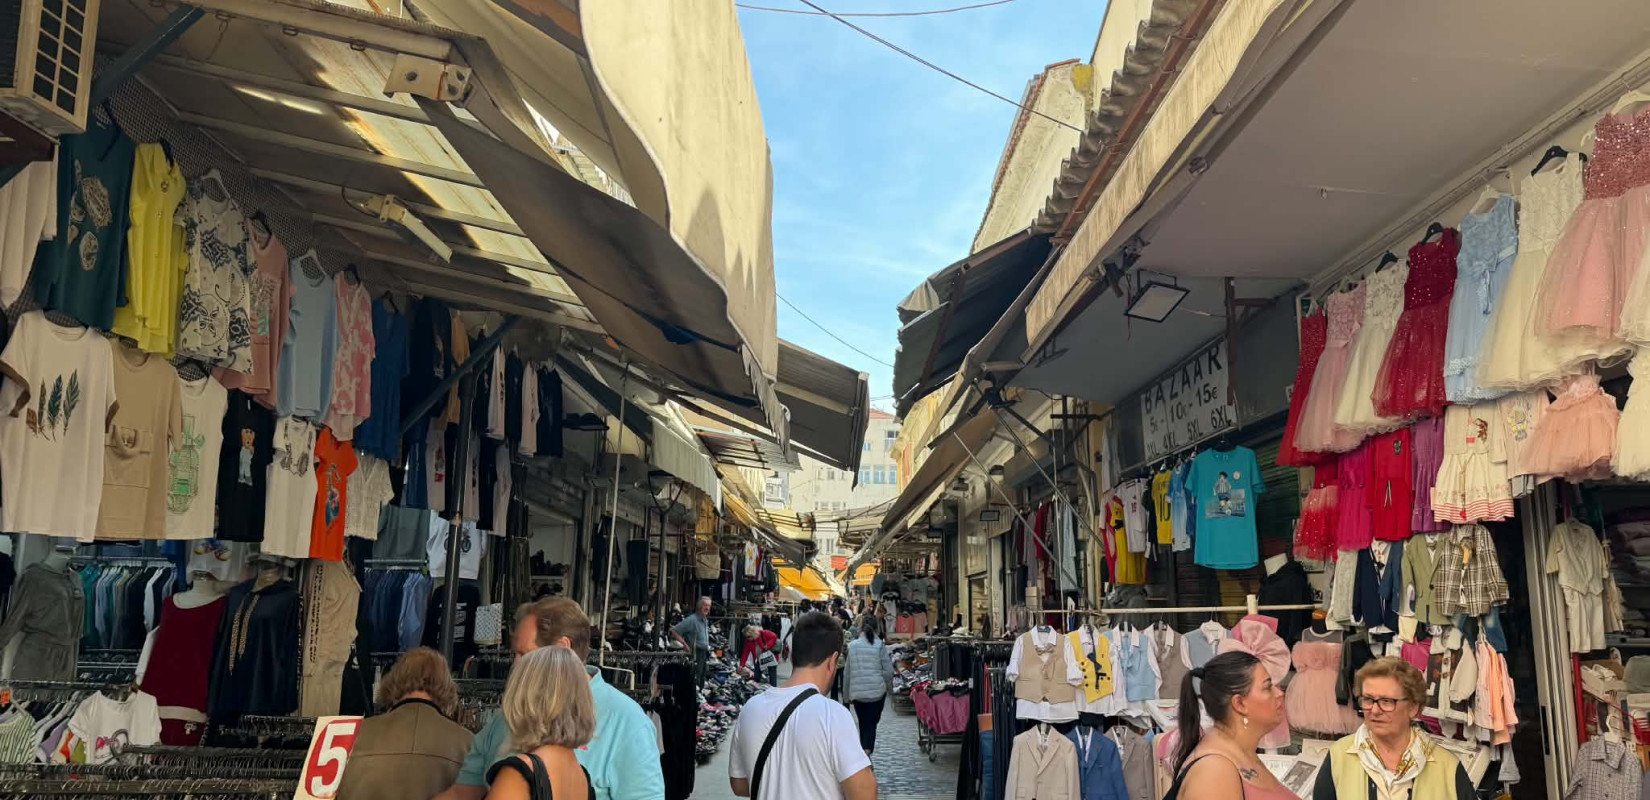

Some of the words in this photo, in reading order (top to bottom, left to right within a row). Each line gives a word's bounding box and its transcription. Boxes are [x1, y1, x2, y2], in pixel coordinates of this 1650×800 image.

[1144, 343, 1222, 414] BAZAAR
[1196, 382, 1218, 407] 15€
[1187, 418, 1204, 441] 5XL
[1211, 404, 1232, 429] 6XL
[311, 722, 357, 798] 5
